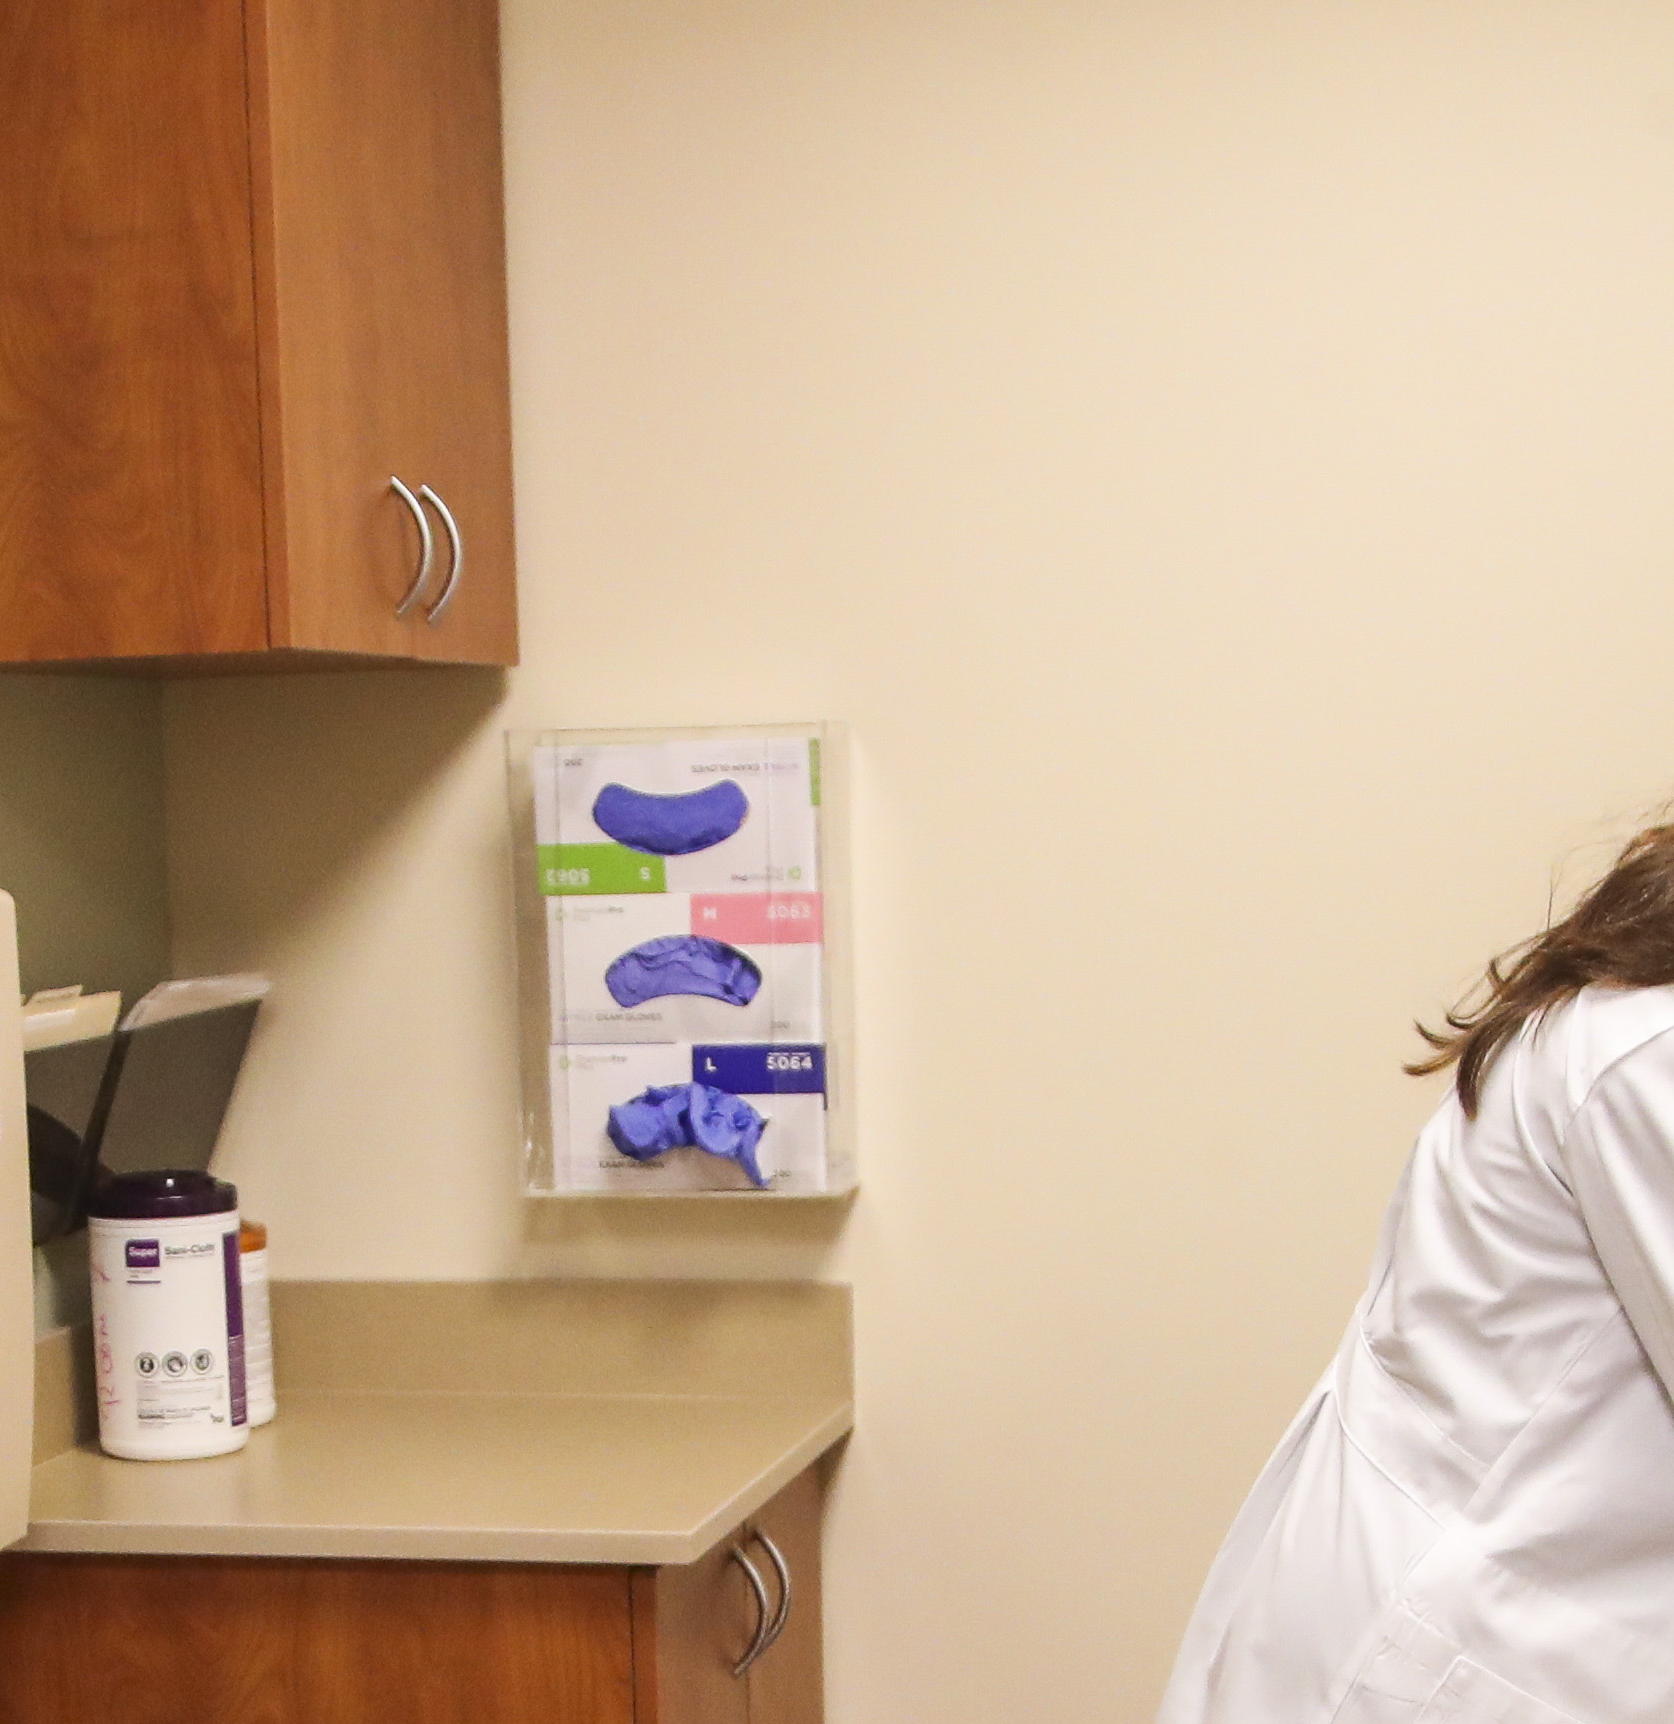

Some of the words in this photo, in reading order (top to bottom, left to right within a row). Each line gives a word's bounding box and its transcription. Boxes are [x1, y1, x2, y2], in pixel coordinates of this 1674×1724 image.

[639, 867, 651, 881] S
[703, 906, 717, 920] M
[705, 1057, 716, 1070] L
[767, 1054, 812, 1070] 5064
[128, 1246, 158, 1258] Super
